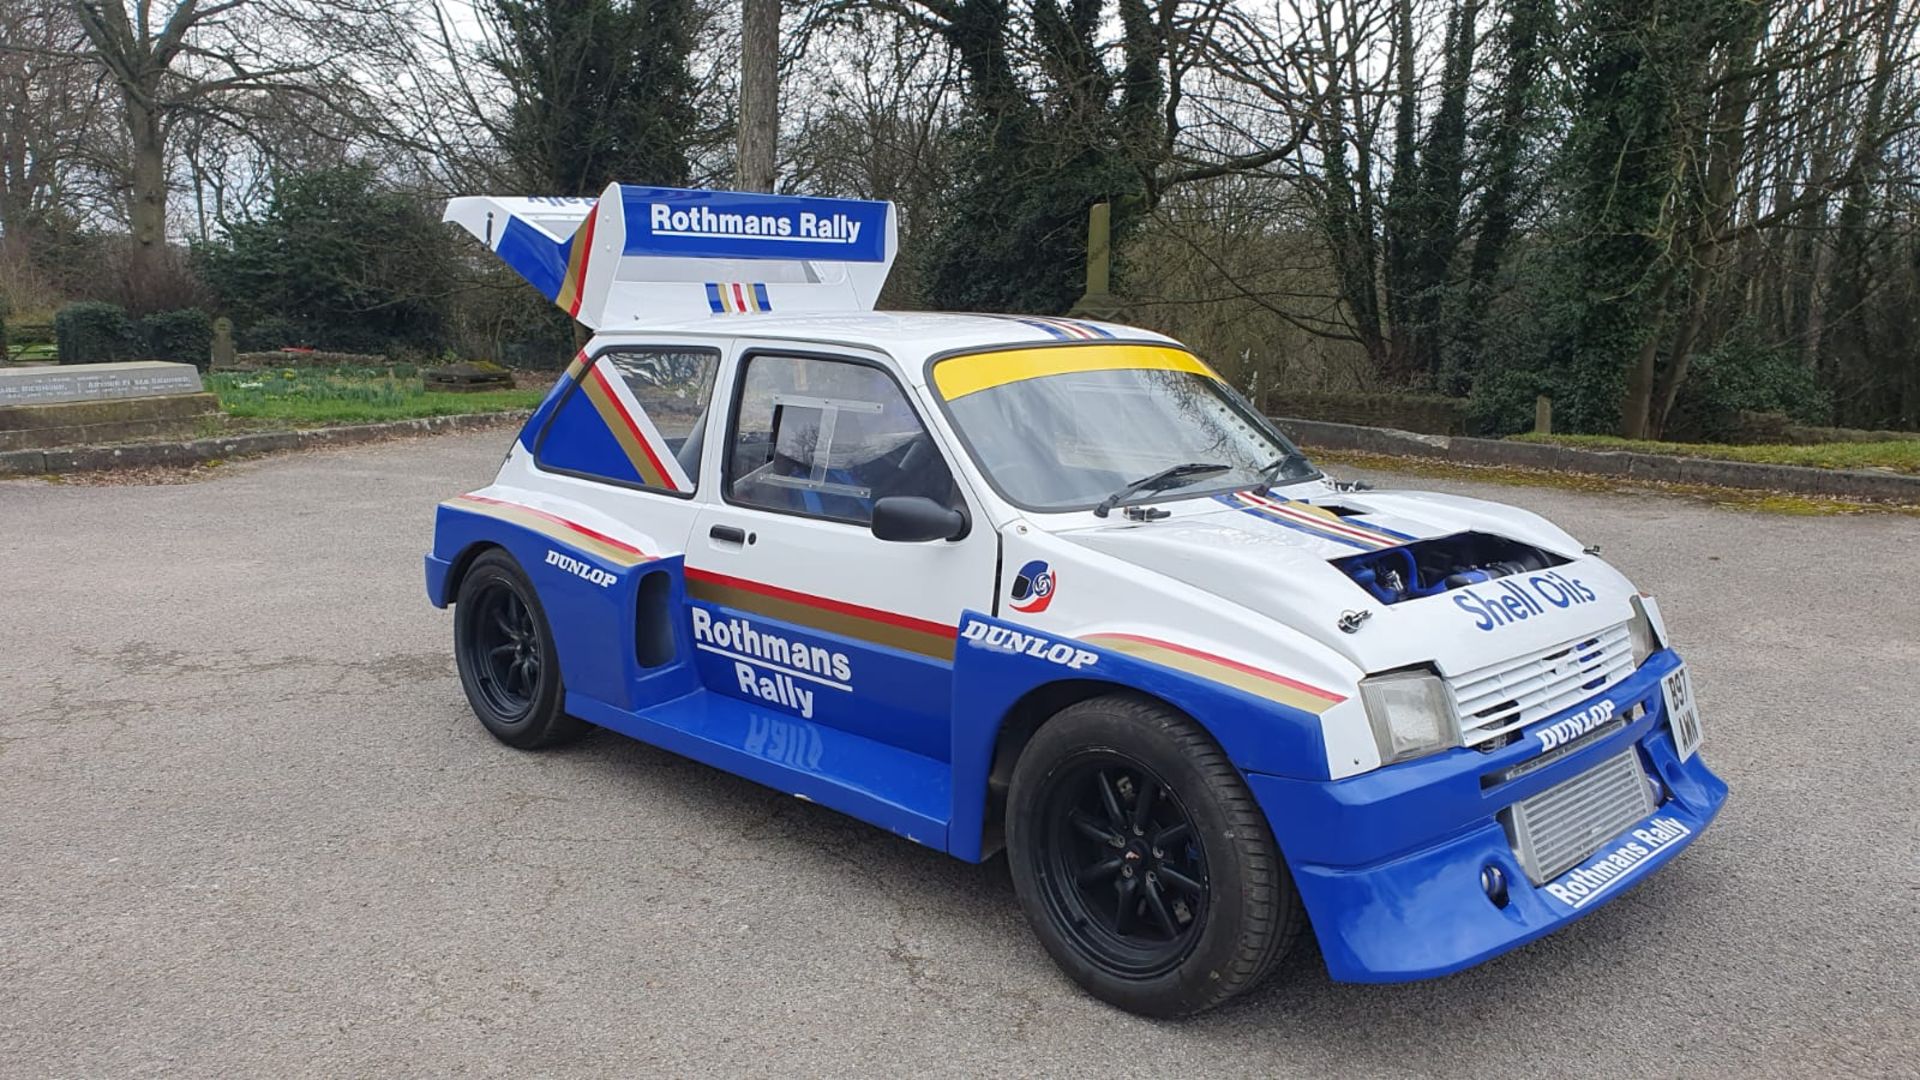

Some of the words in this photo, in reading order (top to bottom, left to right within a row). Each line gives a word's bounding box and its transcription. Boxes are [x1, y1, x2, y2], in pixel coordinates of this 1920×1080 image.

[651, 203, 792, 236] Rothmans
[799, 212, 861, 244] Rally
[545, 549, 618, 588] DUNLOP
[1452, 578, 1544, 632] Shell
[1528, 570, 1596, 609] Oils
[691, 606, 853, 682] Rothmans
[960, 620, 1099, 669] DUNLOP
[734, 661, 814, 719] Rally
[1667, 668, 1688, 712] B97
[1535, 699, 1616, 753] DUNLOP
[1544, 841, 1650, 906] Rothmans
[1631, 817, 1691, 848] Rally
